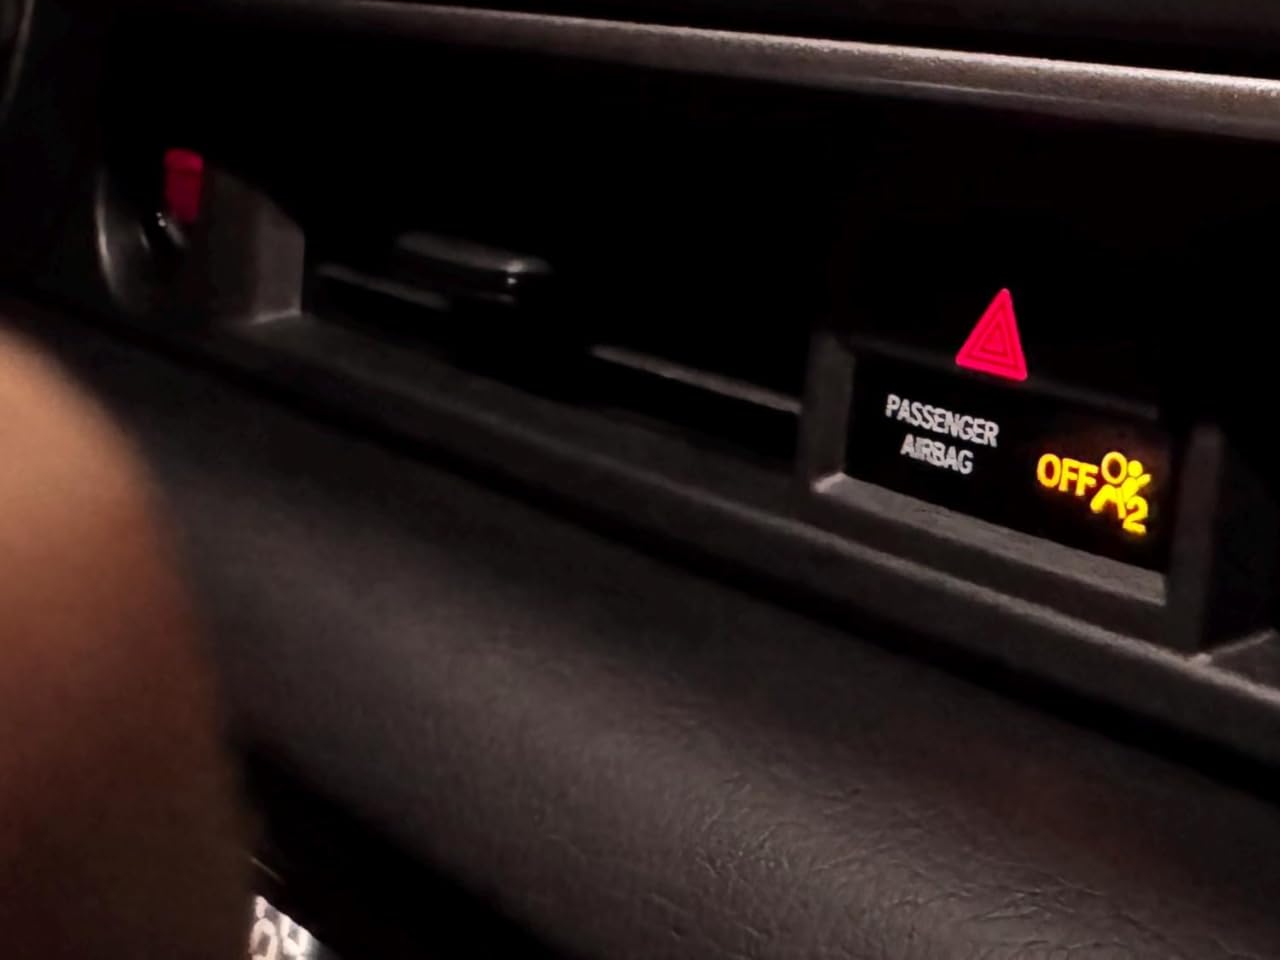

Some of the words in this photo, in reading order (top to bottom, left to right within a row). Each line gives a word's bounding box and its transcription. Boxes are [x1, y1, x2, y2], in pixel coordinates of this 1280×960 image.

[886, 393, 1000, 448] PASSENGER
[900, 433, 975, 475] AIRBAG
[1036, 453, 1098, 497] OFF
